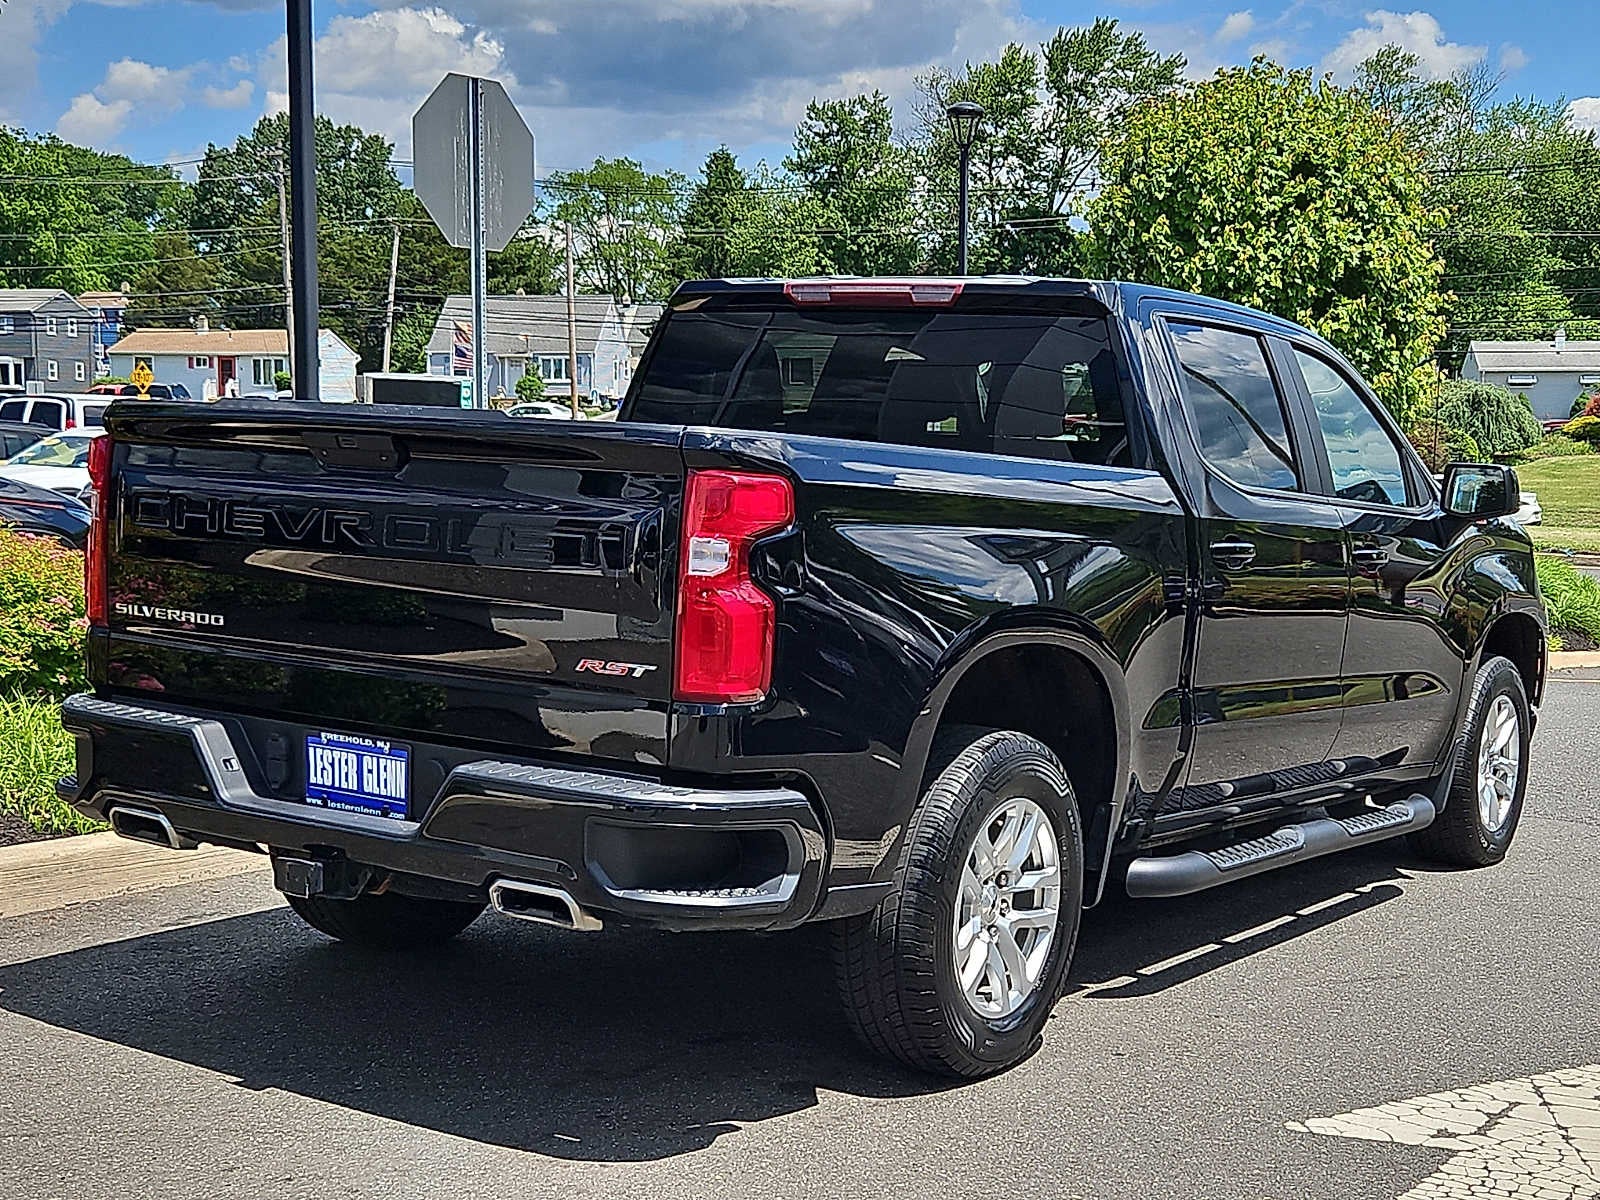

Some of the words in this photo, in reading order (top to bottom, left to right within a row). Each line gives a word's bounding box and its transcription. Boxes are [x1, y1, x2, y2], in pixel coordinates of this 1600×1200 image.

[132, 487, 629, 576] CHEVROLET
[115, 602, 225, 626] SILVERADO
[575, 658, 658, 678] RST
[308, 747, 357, 790] LESTER
[362, 756, 406, 799] GLENN
